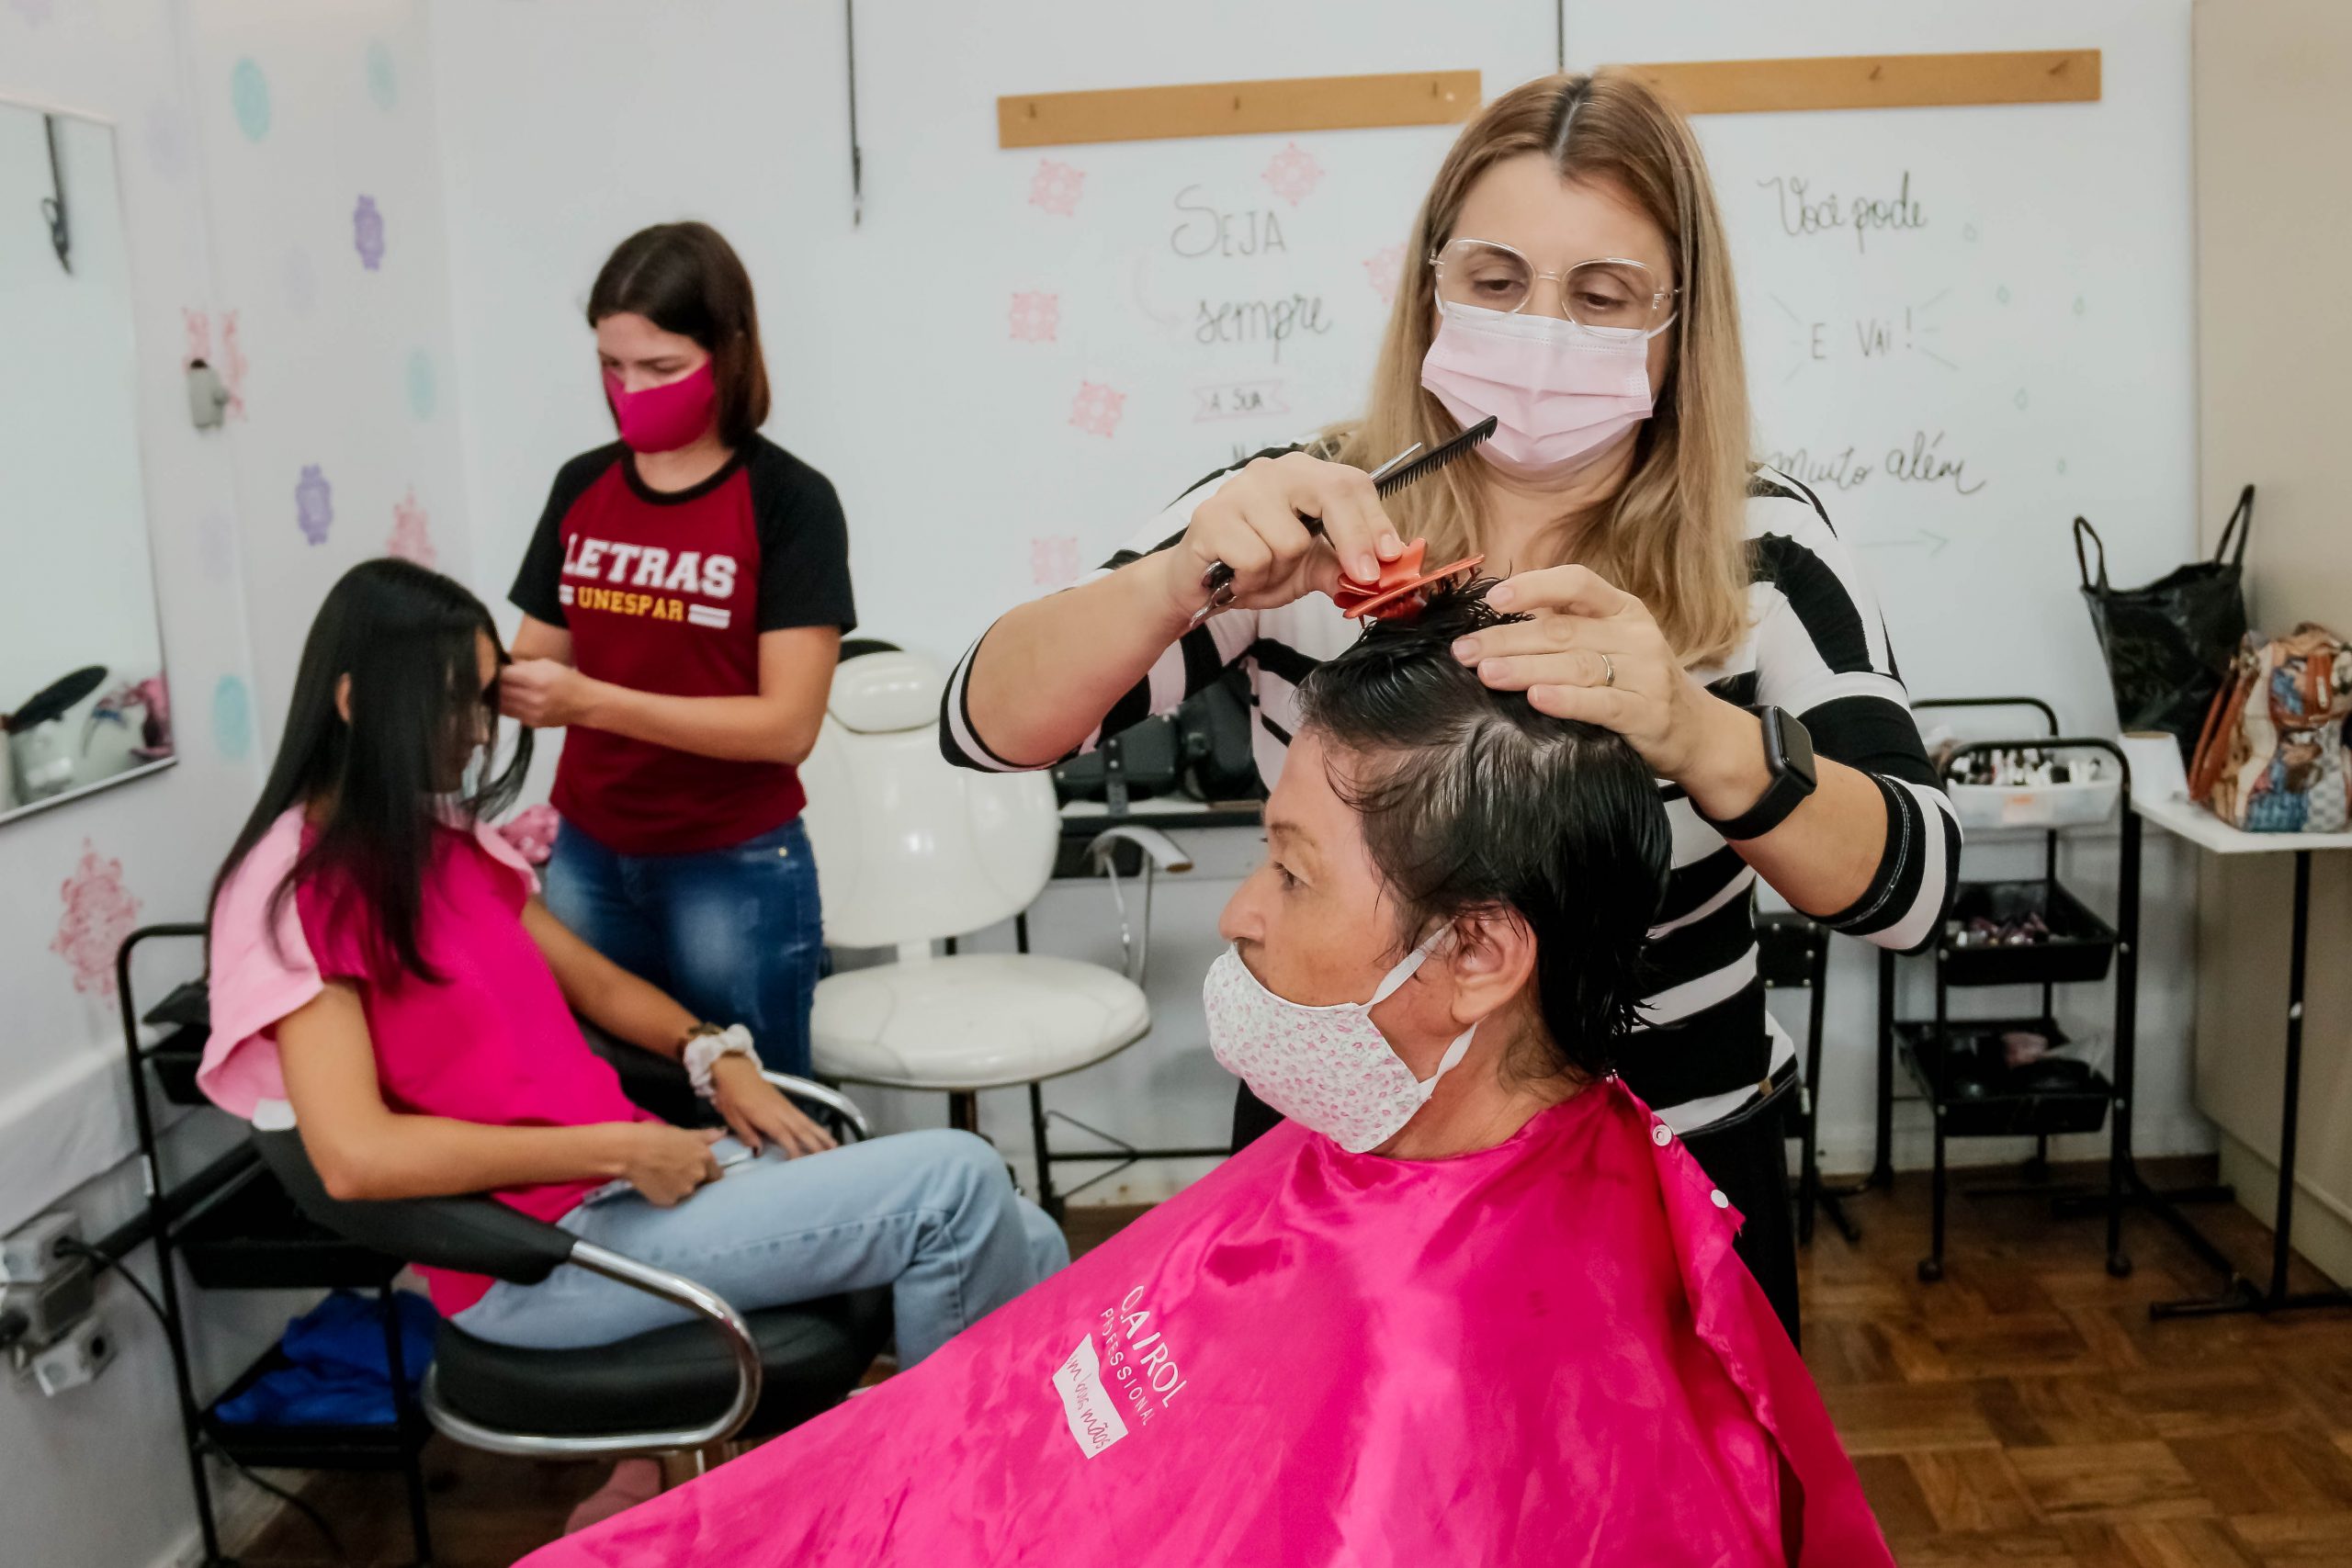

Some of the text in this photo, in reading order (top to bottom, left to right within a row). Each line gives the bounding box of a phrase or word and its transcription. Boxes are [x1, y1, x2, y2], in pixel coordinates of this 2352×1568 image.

[1170, 184, 1287, 258] SEJA
[1851, 171, 1928, 254] pode
[1195, 293, 1333, 364] sempre
[1811, 321, 1826, 360] E
[1209, 392, 1221, 412] A
[1884, 430, 1986, 495] além
[563, 533, 738, 599] LETRAS
[578, 586, 684, 622] UNESPAR
